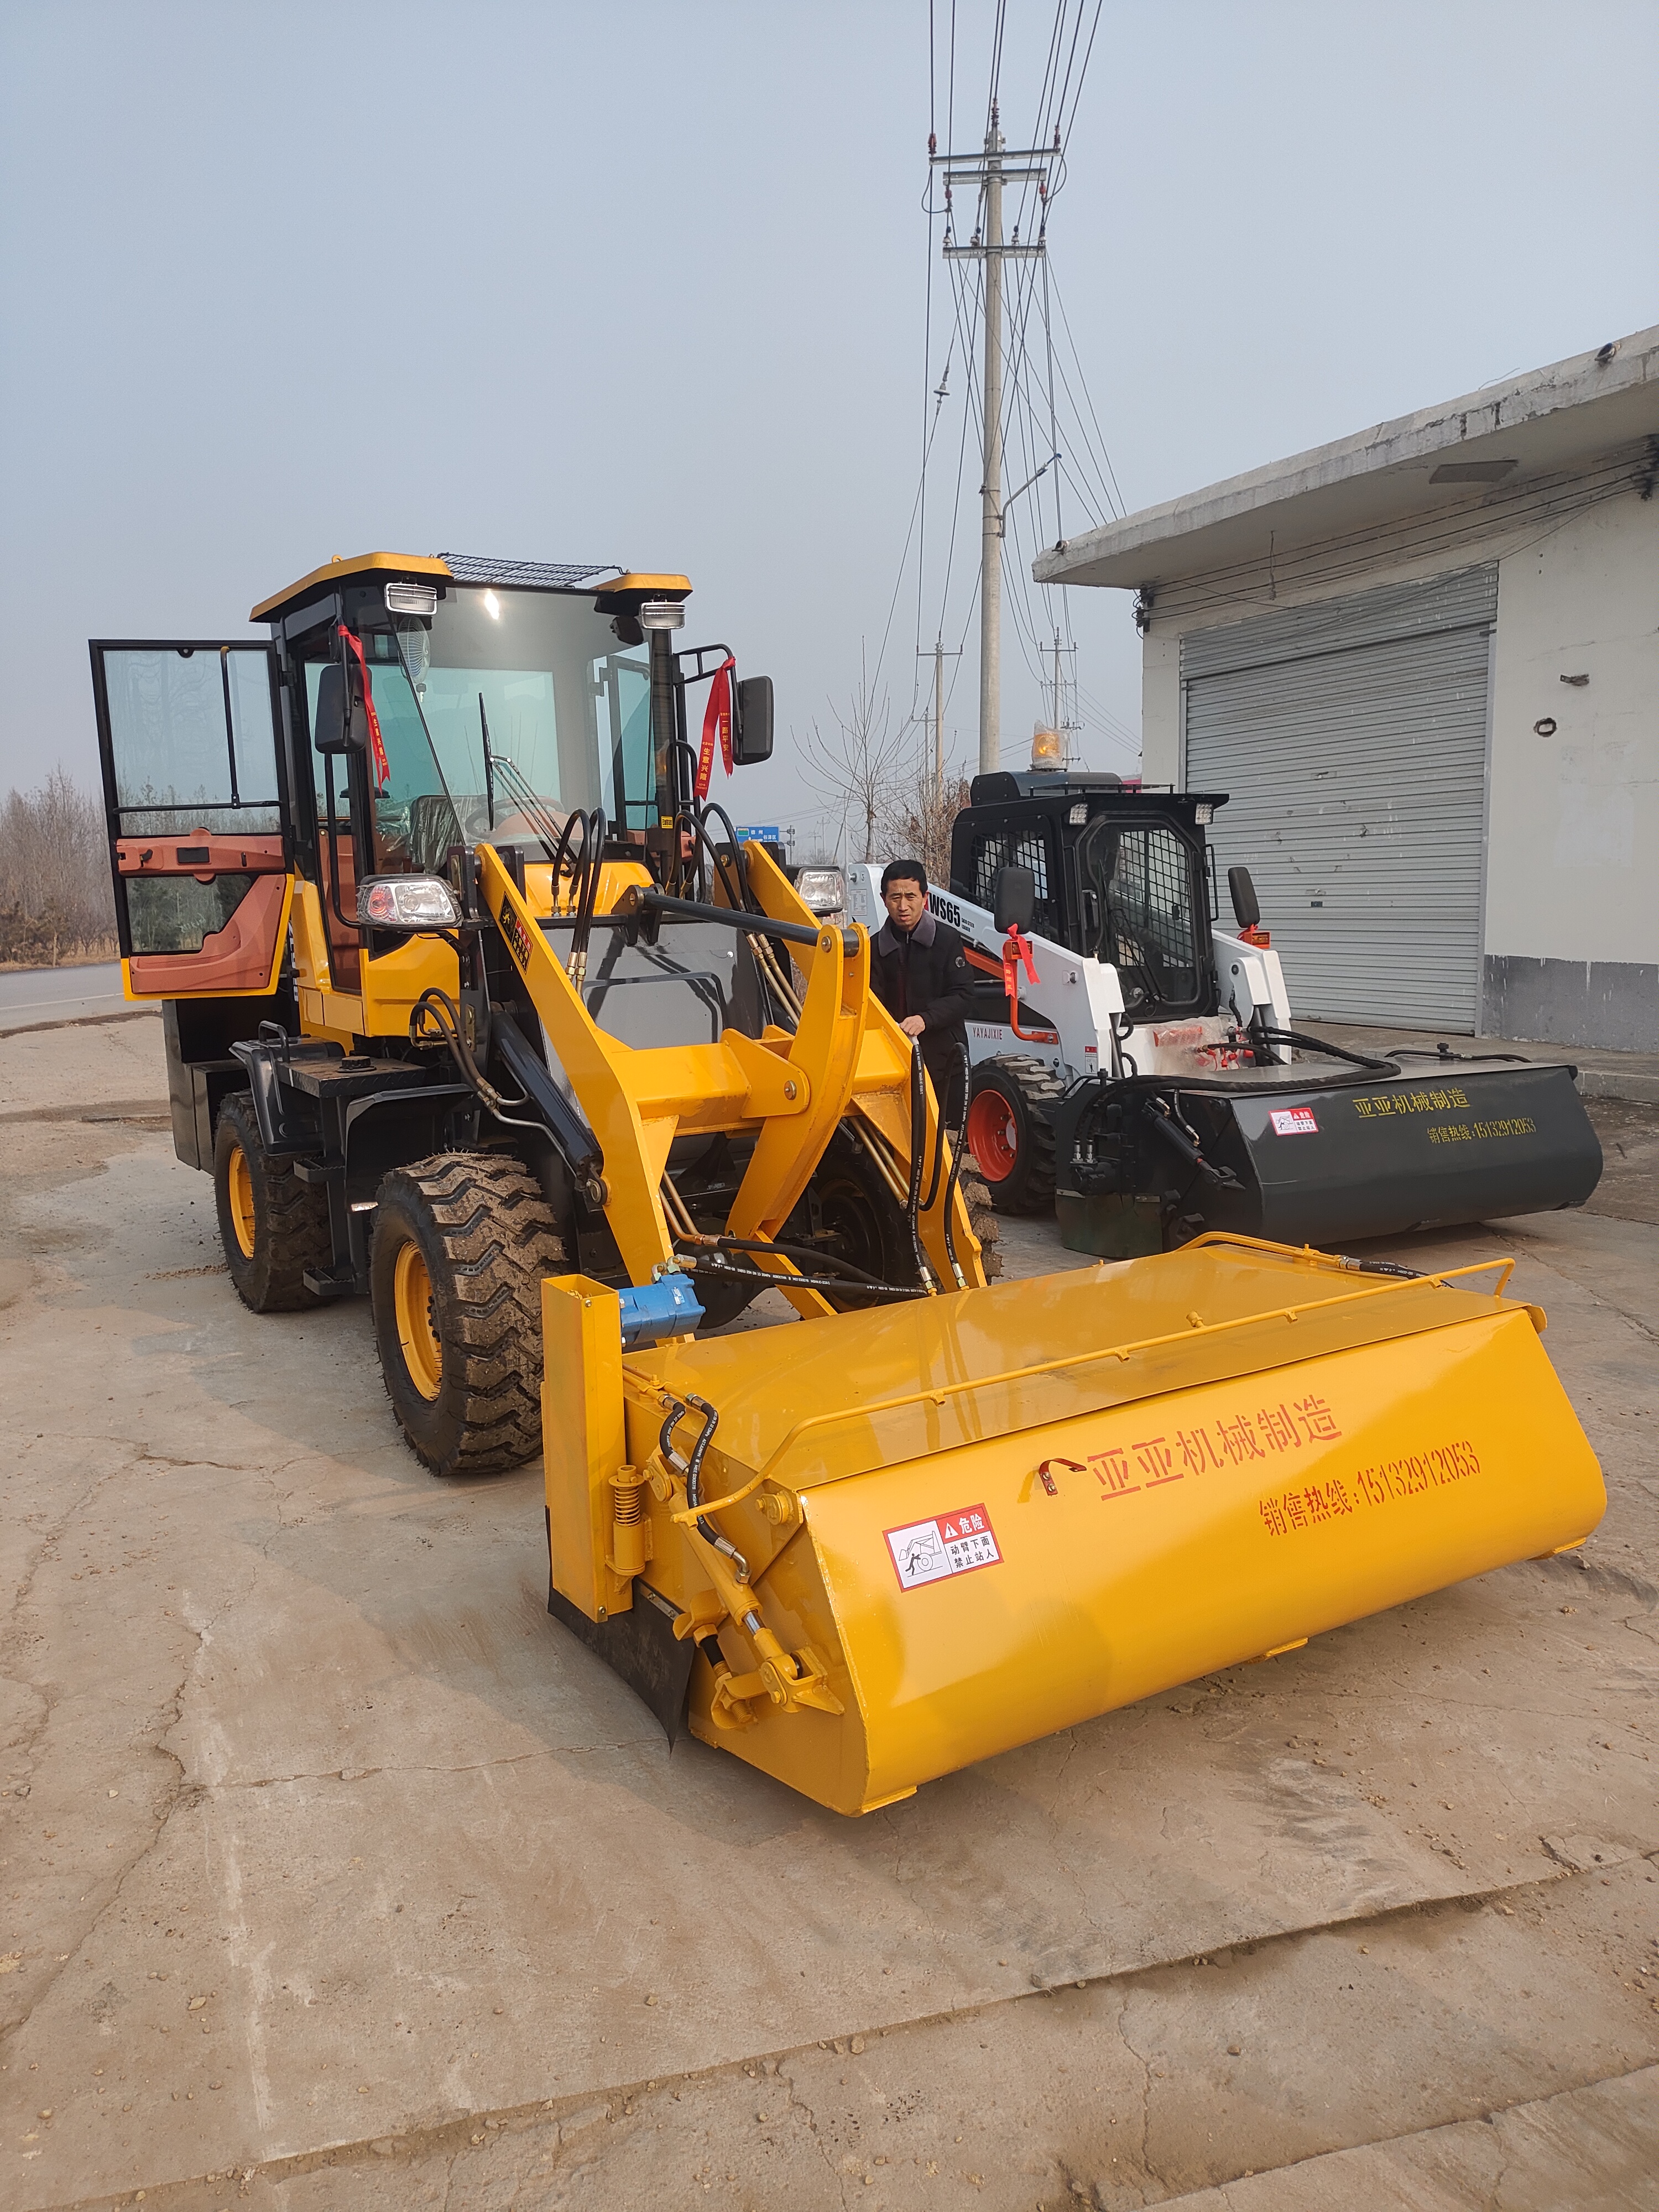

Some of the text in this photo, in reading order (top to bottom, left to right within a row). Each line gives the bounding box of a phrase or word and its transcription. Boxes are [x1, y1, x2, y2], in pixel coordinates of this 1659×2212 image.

[700, 748, 711, 781] 生意兴隆
[928, 892, 961, 927] WS65
[973, 1027, 1003, 1040] YAYAJIXIE
[1352, 1087, 1472, 1119] 亚亚机械制造
[1087, 1394, 1343, 1501] 亚亚机械制造
[1259, 1440, 1481, 1536] 销售热线:15132912053
[958, 1513, 985, 1535] 危险
[950, 1535, 990, 1556] 动臂下面
[954, 1548, 994, 1568] 禁止站人
